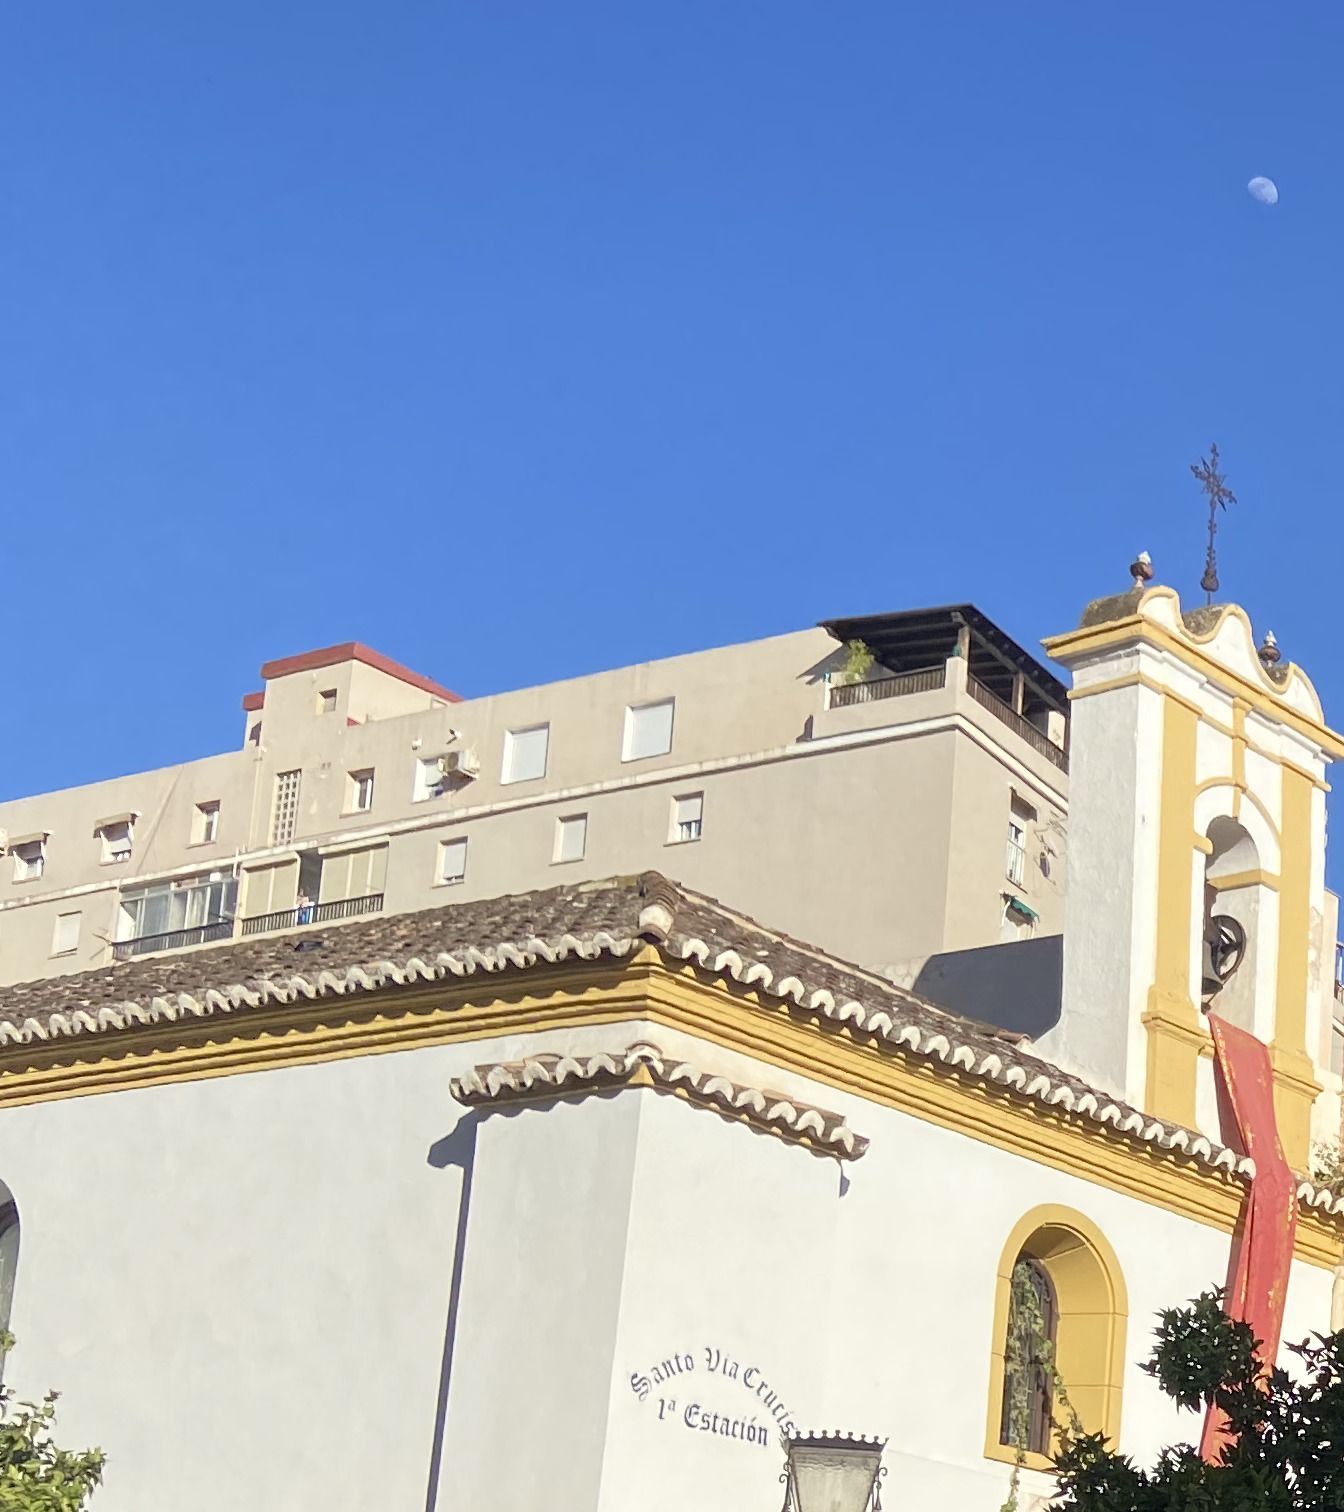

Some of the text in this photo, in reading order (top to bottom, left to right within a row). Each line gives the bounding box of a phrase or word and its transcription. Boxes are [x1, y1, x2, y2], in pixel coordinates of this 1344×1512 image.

[630, 1352, 694, 1401] Santo
[743, 1367, 798, 1437] Crucis
[683, 1403, 768, 1446] Estación
